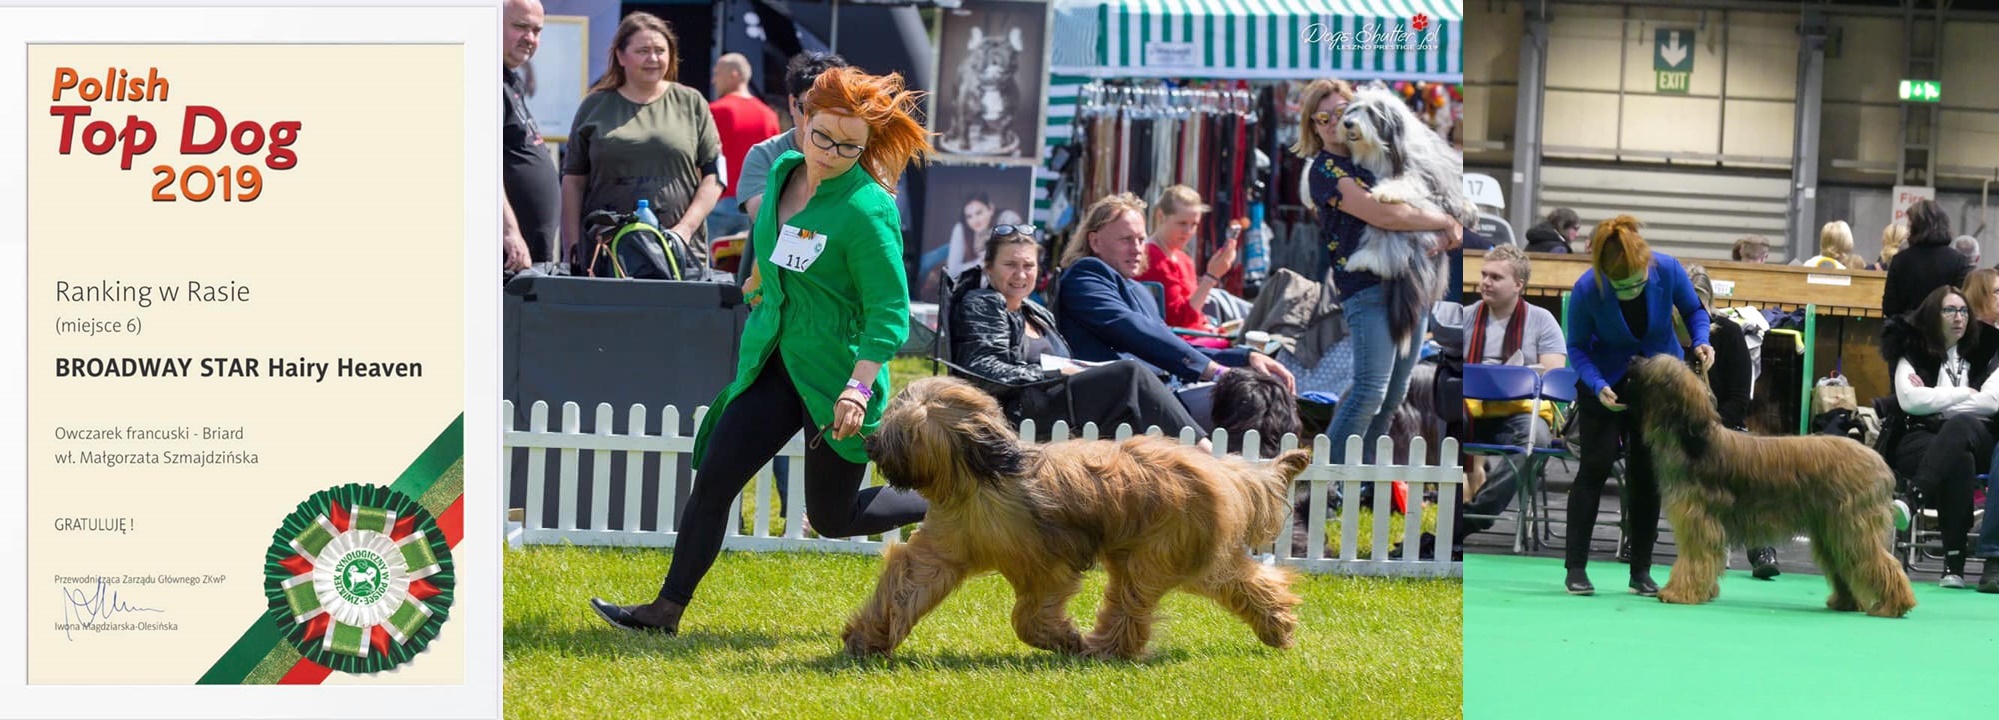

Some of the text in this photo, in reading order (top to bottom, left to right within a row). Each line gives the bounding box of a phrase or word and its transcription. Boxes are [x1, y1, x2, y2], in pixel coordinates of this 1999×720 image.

[52, 67, 169, 102] Polish
[1659, 71, 1688, 90] EXIT
[49, 105, 302, 171] Top Dog
[151, 164, 263, 203] 2019
[1467, 180, 1484, 196] 17
[56, 280, 250, 308] Ranking w Rasie
[55, 317, 142, 337] (miejsce 6)
[55, 357, 423, 383] BROADWAY STAR Hairy Heaven
[54, 425, 123, 440] Owczarek
[126, 425, 190, 440] francuski
[202, 425, 244, 440] Briard
[54, 450, 259, 468] wł. Małgorzata Szmajdzińska
[54, 517, 127, 535] GRATULUJĘ
[54, 574, 227, 587] Przewodnicząca Zarządu Głównego ZKwP
[335, 550, 388, 572] KYNOLOGICZNY
[363, 581, 389, 605] POLSCE
[54, 621, 179, 633] Iwona Magdziarska-Olesińska
